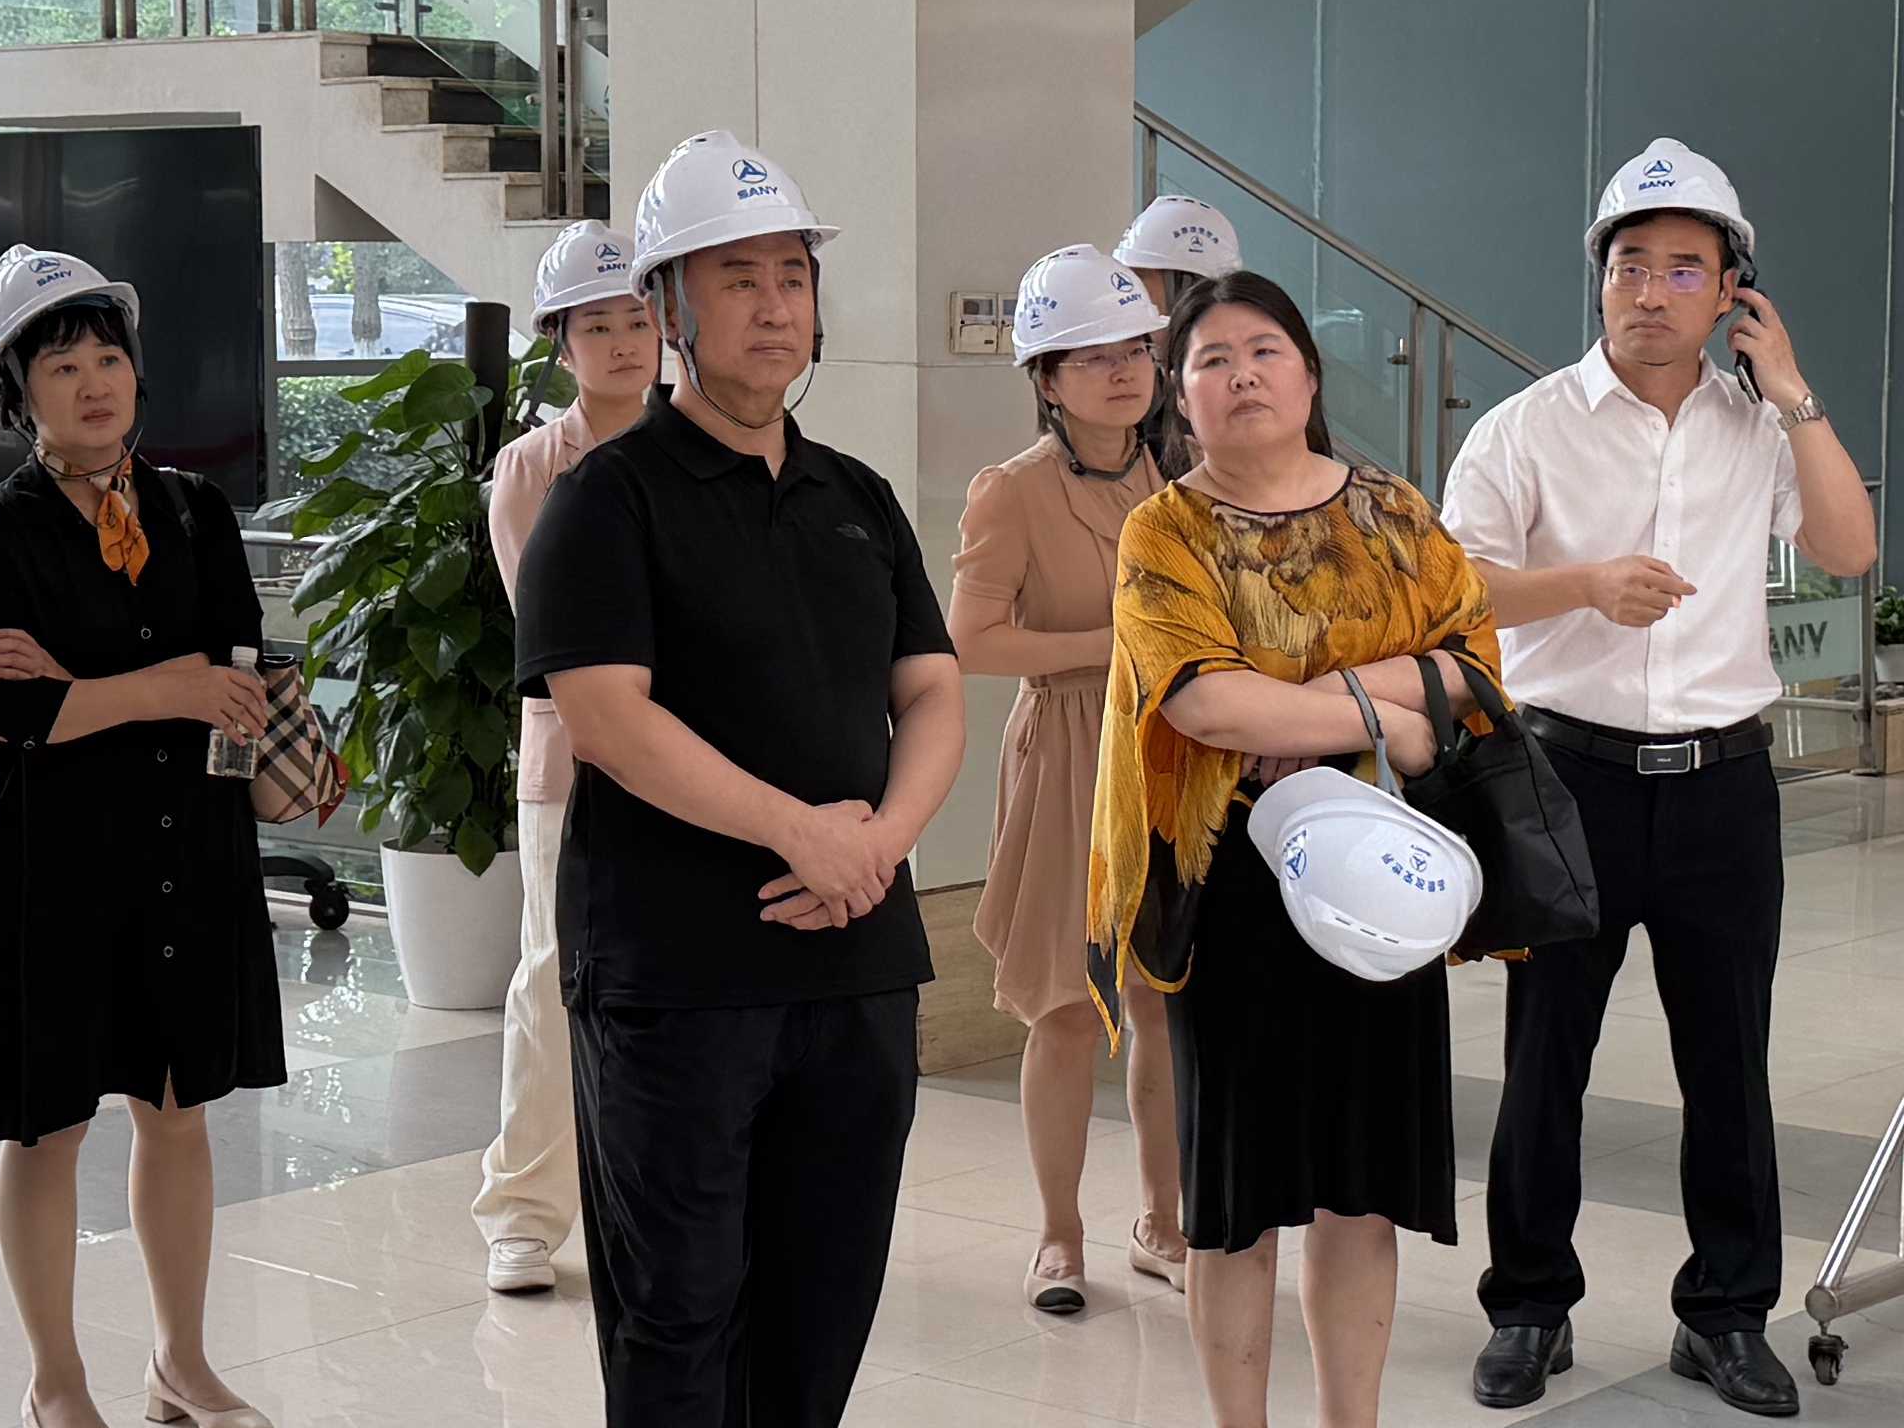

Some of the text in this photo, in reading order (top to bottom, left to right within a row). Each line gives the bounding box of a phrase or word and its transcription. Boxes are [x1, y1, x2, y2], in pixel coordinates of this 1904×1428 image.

[1638, 180, 1676, 191] SANY
[736, 186, 779, 201] SANY
[597, 262, 627, 274] SANY
[1118, 292, 1143, 306] SANY
[1769, 620, 1828, 664] ANY
